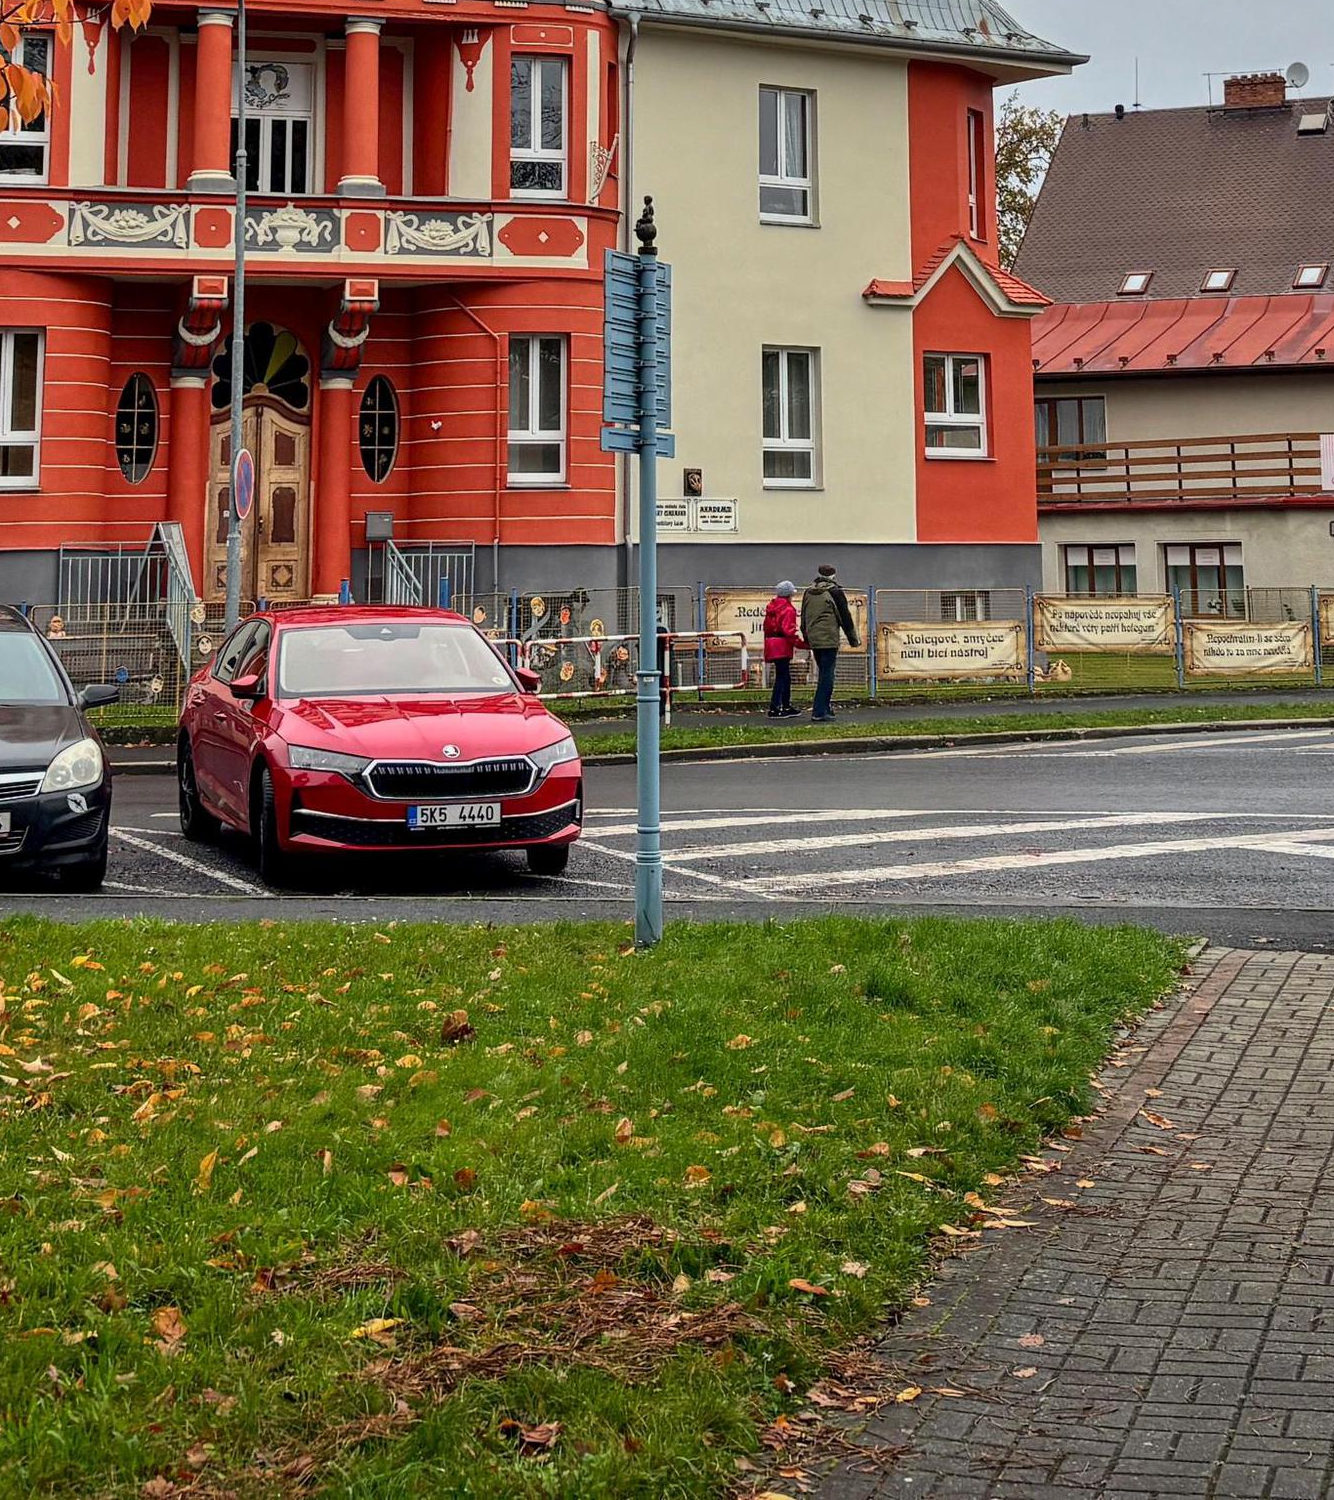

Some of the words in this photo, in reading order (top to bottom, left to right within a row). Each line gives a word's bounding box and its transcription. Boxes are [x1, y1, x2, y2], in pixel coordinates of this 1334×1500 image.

[900, 648, 924, 659] není
[927, 648, 947, 659] bicí
[420, 807, 447, 824] 5K5
[459, 805, 494, 822] 4440
